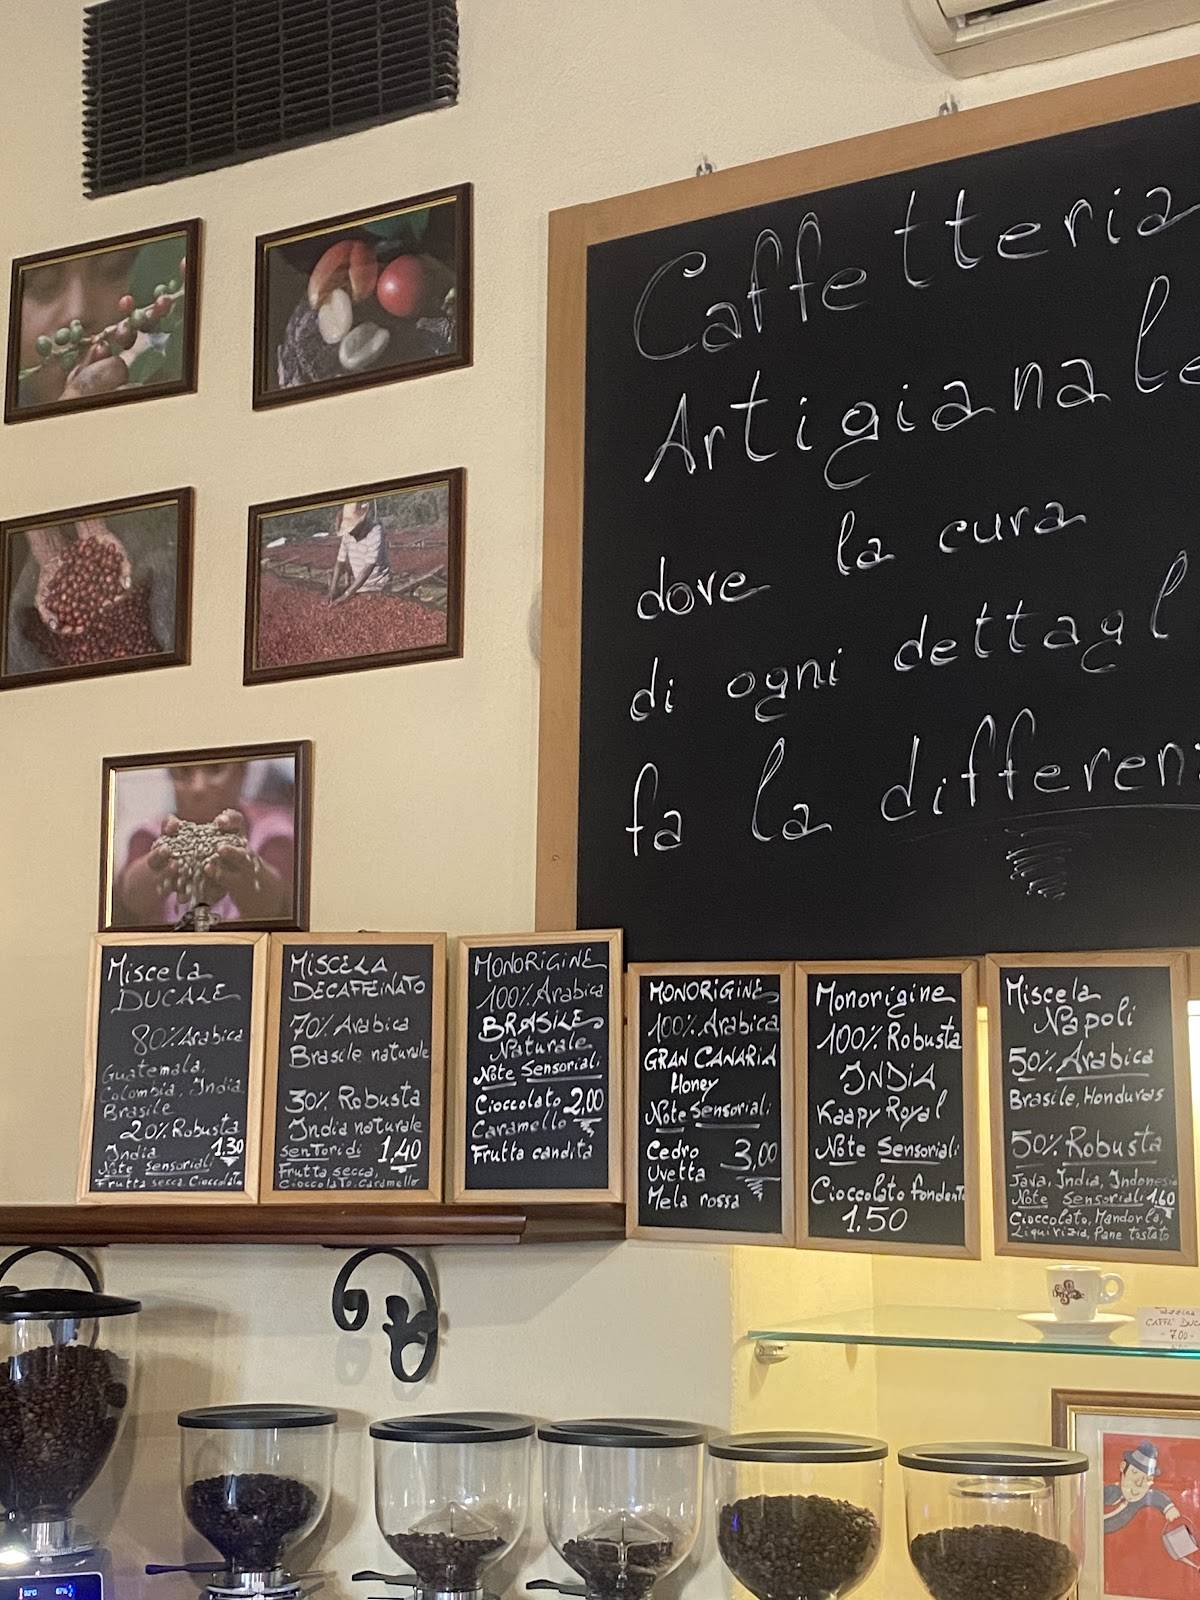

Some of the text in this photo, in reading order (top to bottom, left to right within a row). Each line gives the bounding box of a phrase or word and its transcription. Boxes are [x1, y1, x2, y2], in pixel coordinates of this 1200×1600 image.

[633, 186, 1200, 360] Caffetteria
[636, 501, 1087, 620] dove la cura
[630, 656, 675, 722] di
[726, 647, 843, 723] ogni
[626, 762, 683, 857] fa
[751, 736, 833, 842] la
[107, 951, 213, 987] Miscela
[111, 984, 242, 1014] DUCALE
[476, 976, 604, 1012] 100% Arabica
[816, 980, 956, 1018] Monorigine
[1005, 974, 1101, 1014] Miscela
[289, 1012, 409, 1042] 70% Arabica
[648, 1007, 779, 1043] 100% Arabica
[1033, 995, 1136, 1038] Napoli
[132, 1024, 244, 1056] 80% Arabica
[490, 1031, 592, 1063] Naturale
[816, 1015, 962, 1055] 100% Robusta
[289, 1040, 430, 1068] Brasile naturale
[473, 1051, 601, 1086] Note Sensoriali
[644, 1047, 688, 1071] GRAN
[1008, 1039, 1153, 1077] 50% Arabica
[285, 1080, 421, 1114] 30% Robusta
[670, 1071, 720, 1102] Honey
[1009, 1083, 1165, 1110] Brasile, Honduras
[103, 1098, 175, 1121] Brasile
[475, 1088, 561, 1116] Cioccolato
[645, 1099, 687, 1126] Note
[816, 1088, 948, 1132] Kaapy Royal
[120, 1113, 240, 1142] 20% Robusta
[289, 1113, 424, 1141] India naturale
[472, 1110, 567, 1139] Caramello
[105, 1144, 157, 1162] India
[471, 1138, 593, 1164] Frutta candita
[646, 1139, 699, 1161] Cedro
[815, 1133, 960, 1160] Note Sensoriali
[1010, 1122, 1162, 1159] 50% Robusta
[98, 1161, 133, 1176] Note
[278, 1163, 327, 1179] Frutta
[647, 1160, 706, 1182] Uvetta
[1009, 1173, 1051, 1188] Java,
[648, 1184, 740, 1211] Mela rossa
[810, 1173, 905, 1204] Cioccolato
[1012, 1189, 1049, 1206] Note
[1009, 1206, 1164, 1227] Cioccolato, Mandorla,
[1093, 1227, 1123, 1242] Pane
